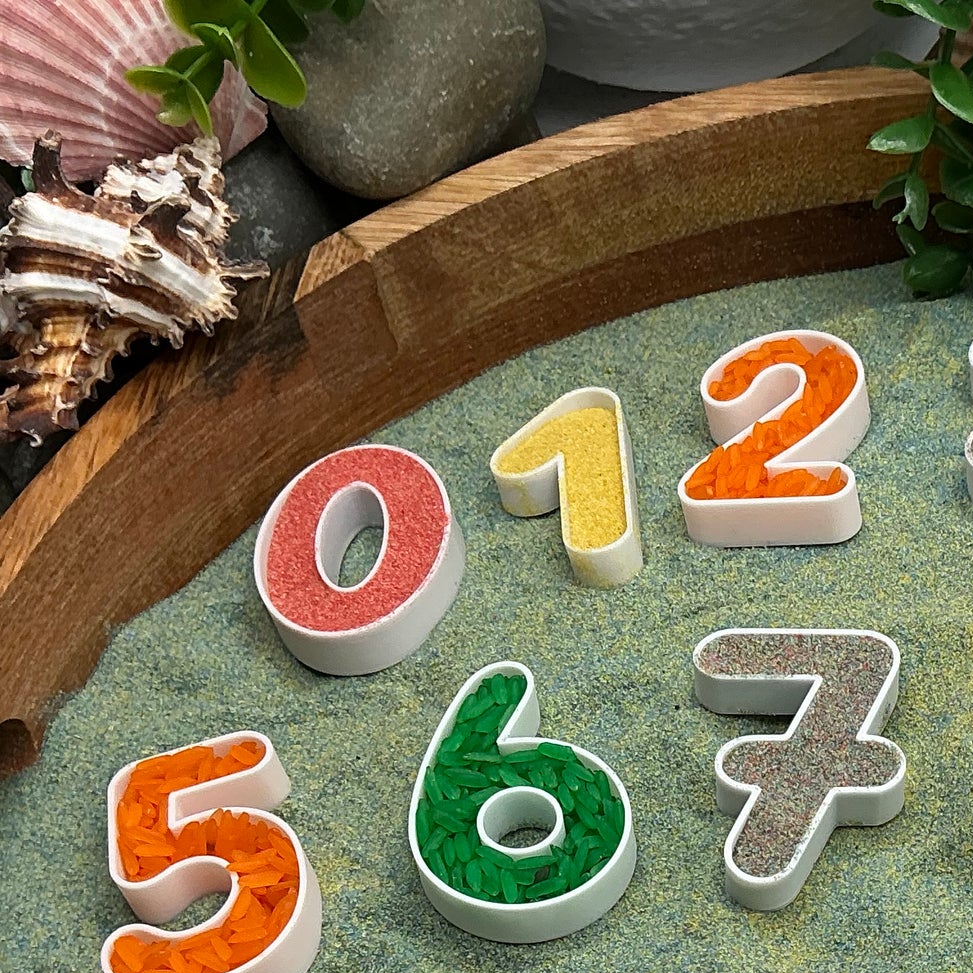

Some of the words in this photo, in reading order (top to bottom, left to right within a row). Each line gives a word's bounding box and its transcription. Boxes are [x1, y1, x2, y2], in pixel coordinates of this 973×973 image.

[255, 444, 464, 674] 0
[491, 387, 643, 586] 1
[680, 329, 869, 545] 2
[409, 661, 636, 940] 6
[692, 628, 907, 909] 7
